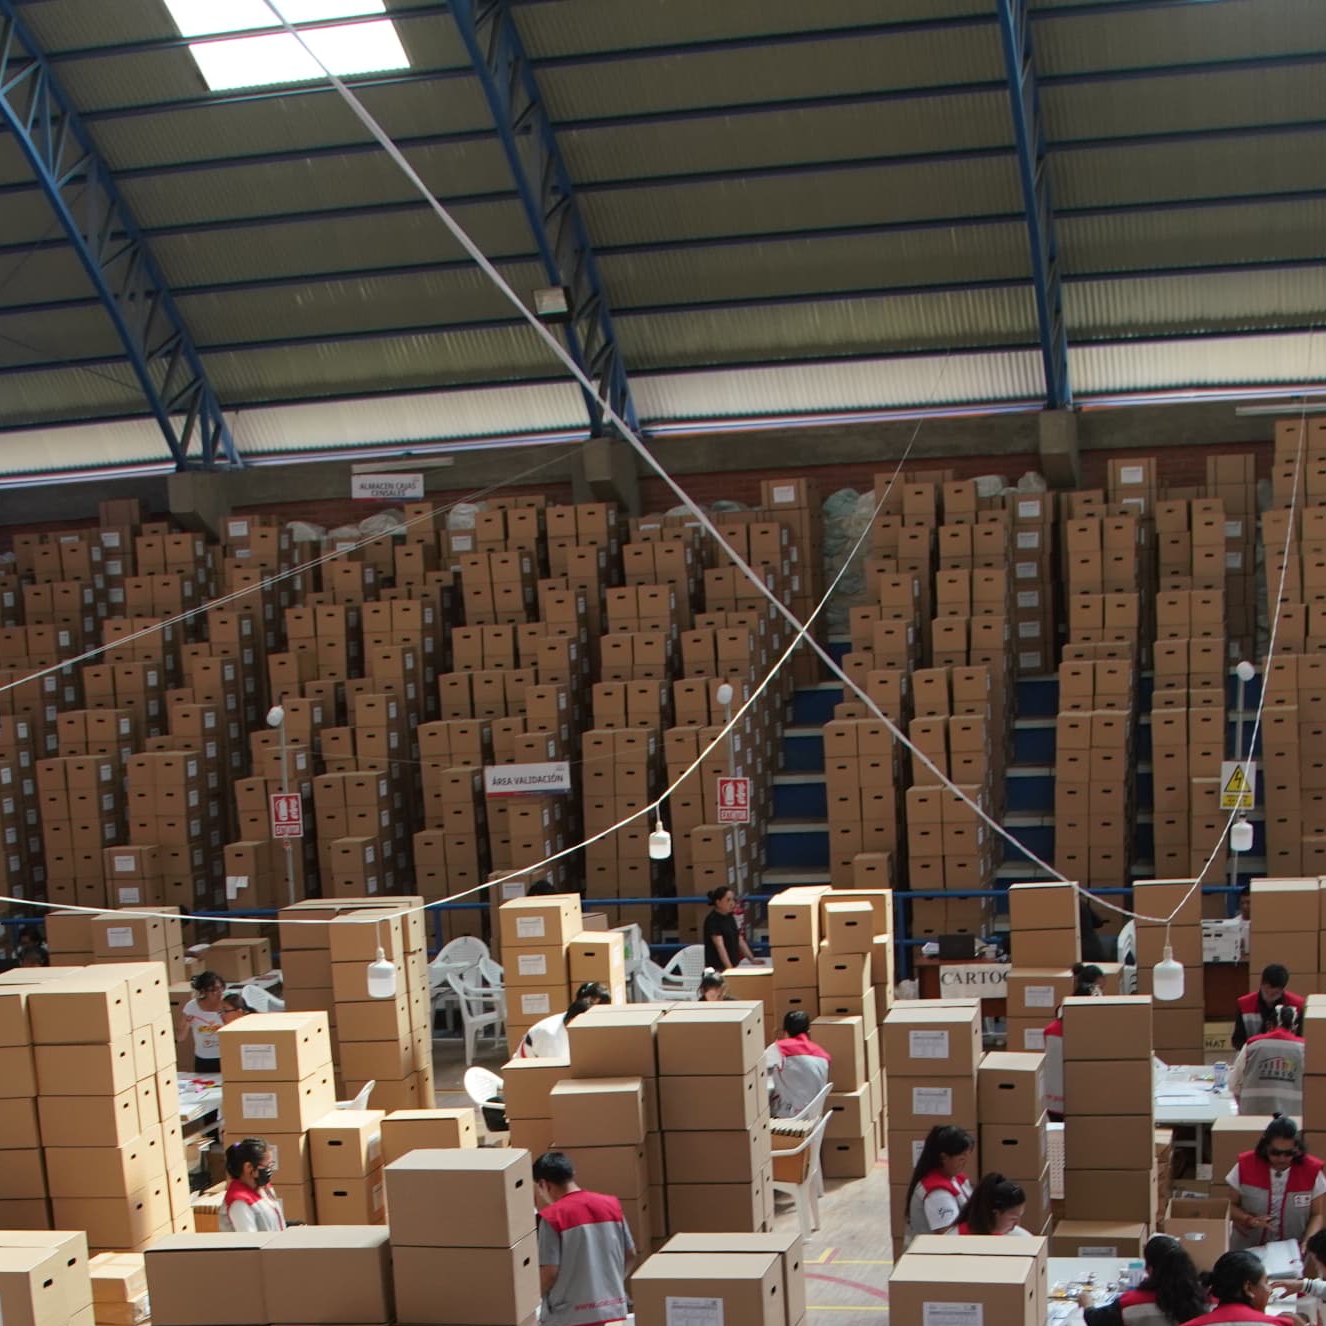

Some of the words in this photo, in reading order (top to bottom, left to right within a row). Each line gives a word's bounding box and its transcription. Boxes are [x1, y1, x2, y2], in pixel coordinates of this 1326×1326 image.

[396, 482, 416, 490] CAJAS
[371, 489, 406, 497] CENSALES
[513, 773, 564, 785] VALIDACIÓN
